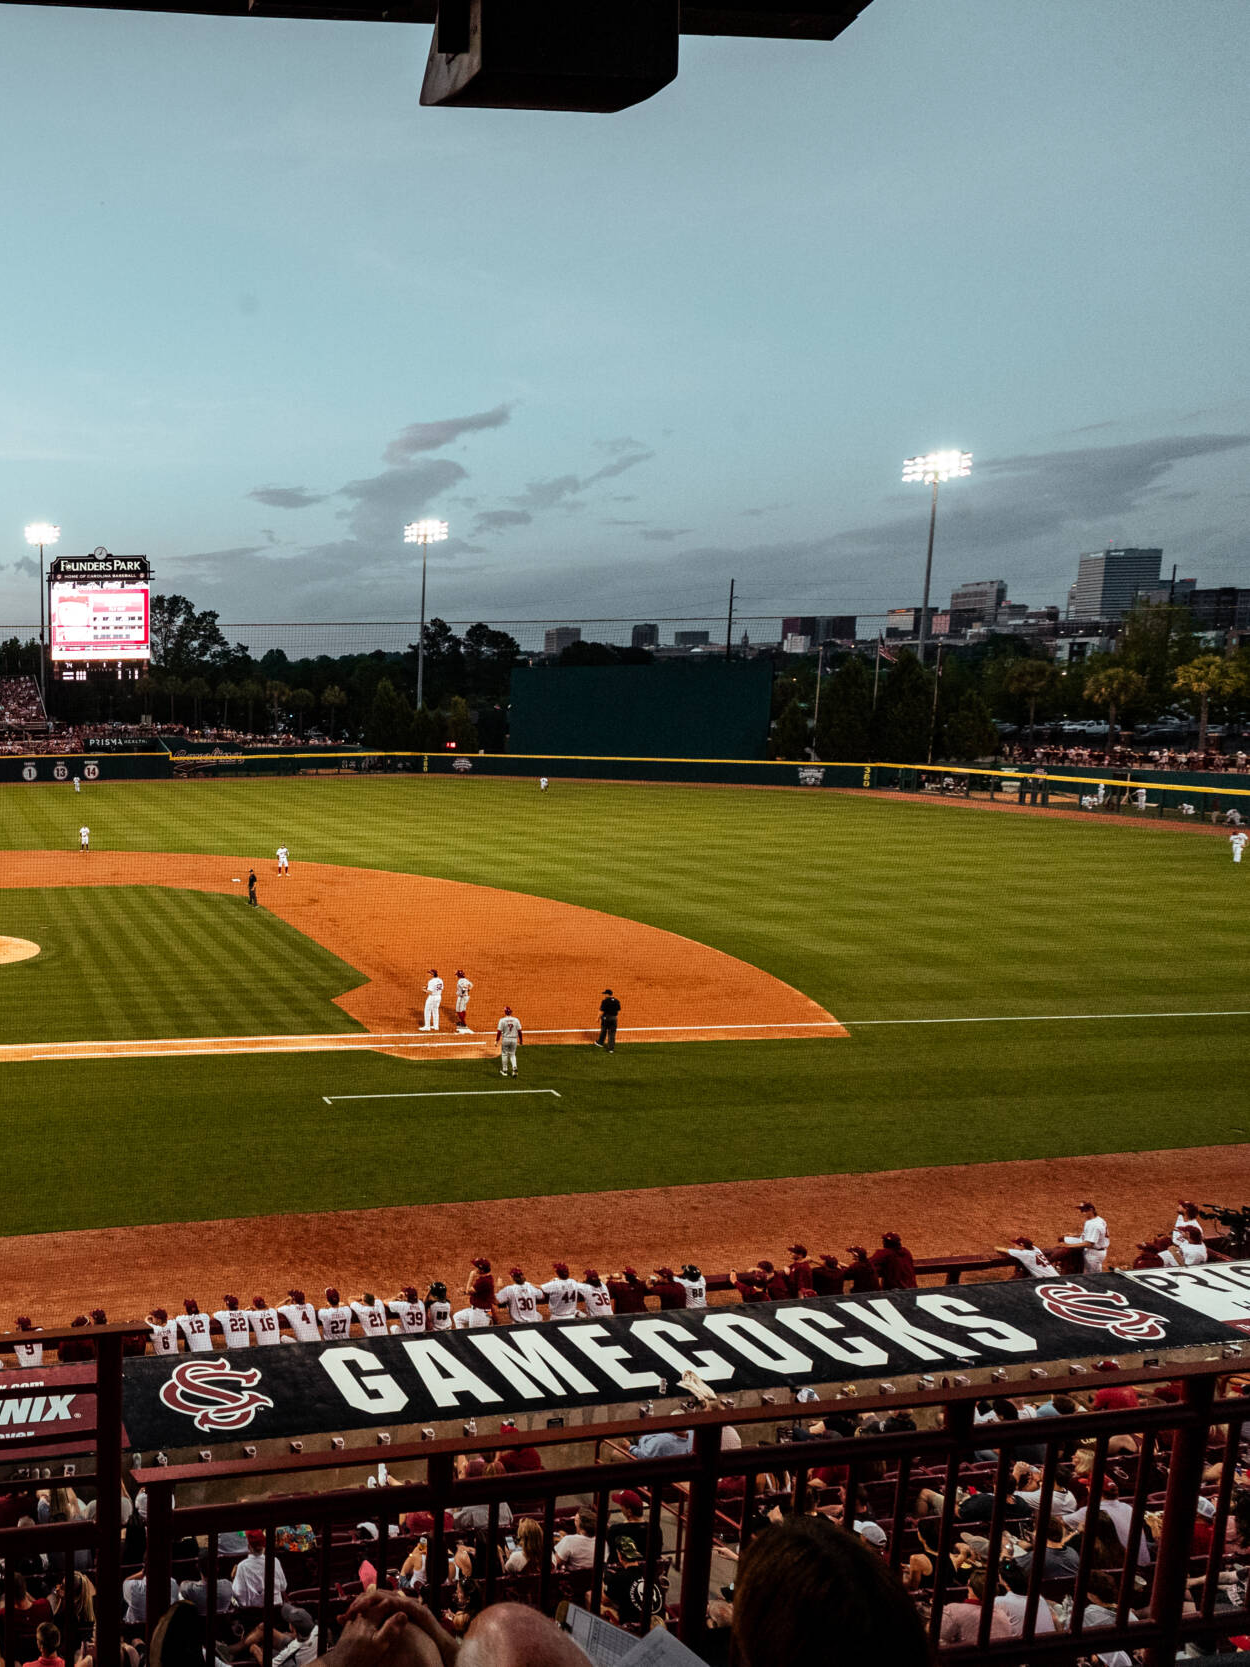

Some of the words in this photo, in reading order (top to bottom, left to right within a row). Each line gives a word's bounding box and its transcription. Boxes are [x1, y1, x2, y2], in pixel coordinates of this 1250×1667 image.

[61, 560, 112, 571] FOUNDERS
[113, 560, 141, 570] PARK
[89, 738, 123, 746] PRISMA
[28, 769, 32, 778] 1
[56, 768, 66, 778] 13
[87, 767, 96, 777] 14
[863, 766, 871, 787] 360
[517, 1297, 534, 1311] 30
[561, 1290, 576, 1304] 44
[591, 1292, 610, 1306] 36
[260, 1317, 275, 1332] 16
[301, 1311, 310, 1324] 4
[368, 1312, 384, 1328] 21
[406, 1311, 423, 1326] 39
[189, 1319, 205, 1334] 12
[229, 1318, 247, 1332] 22
[330, 1319, 347, 1334] 27
[25, 1343, 34, 1355] 9
[162, 1336, 170, 1350] 6
[317, 1293, 1038, 1415] GAMECOCKS
